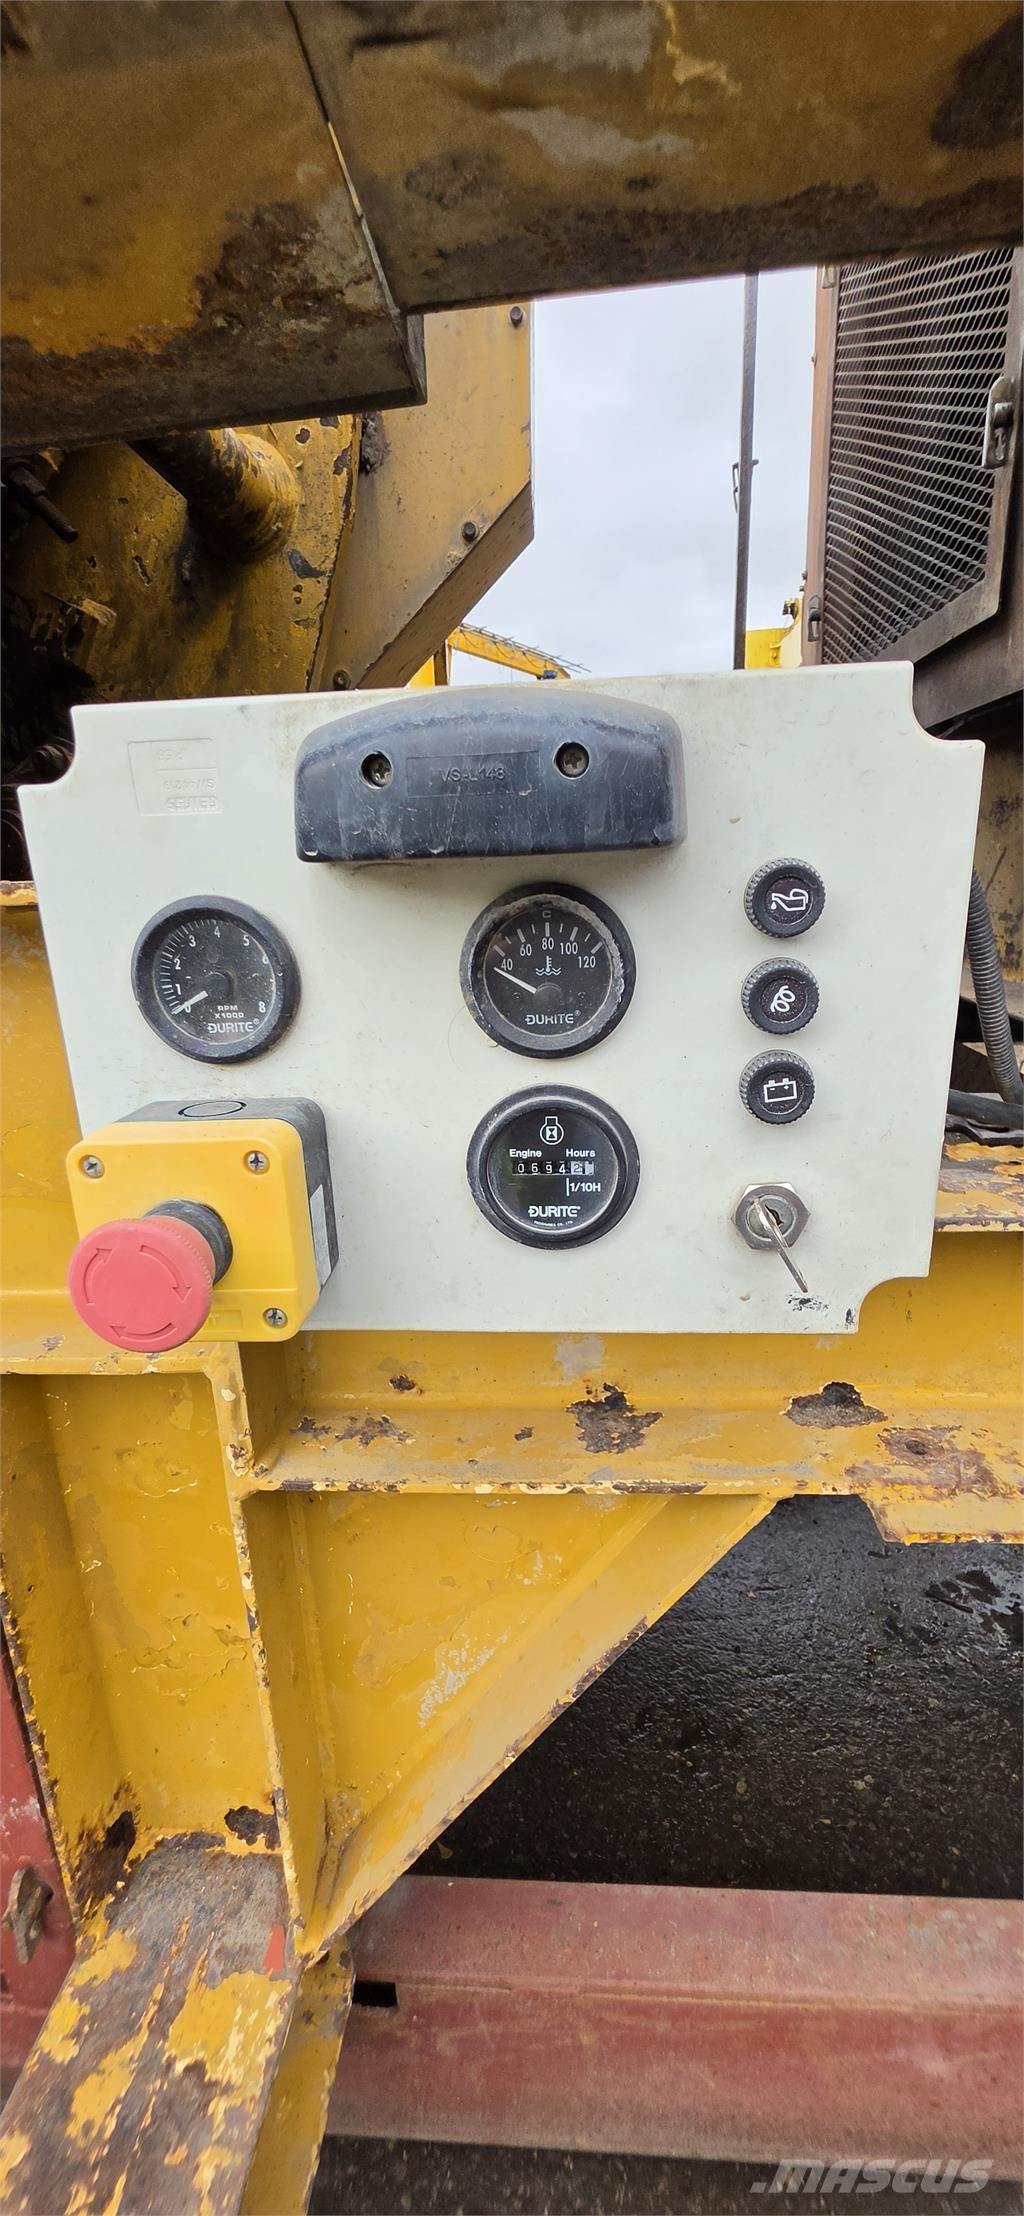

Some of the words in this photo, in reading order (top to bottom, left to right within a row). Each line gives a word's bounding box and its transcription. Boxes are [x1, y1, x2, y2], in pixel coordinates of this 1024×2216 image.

[542, 910, 552, 919] C
[213, 926, 221, 939] 4
[188, 934, 196, 948] 3
[242, 933, 250, 946] 5
[541, 937, 554, 950] 80
[519, 943, 532, 957] 60
[559, 942, 578, 955] 100
[174, 957, 182, 970] 2
[500, 958, 513, 971] 40
[577, 955, 596, 969] 120
[175, 984, 181, 995] 1
[258, 1001, 267, 1013] 8
[509, 1148, 542, 1159] Engine
[565, 1148, 596, 1158] Hours
[569, 1182, 601, 1192] 1/10H
